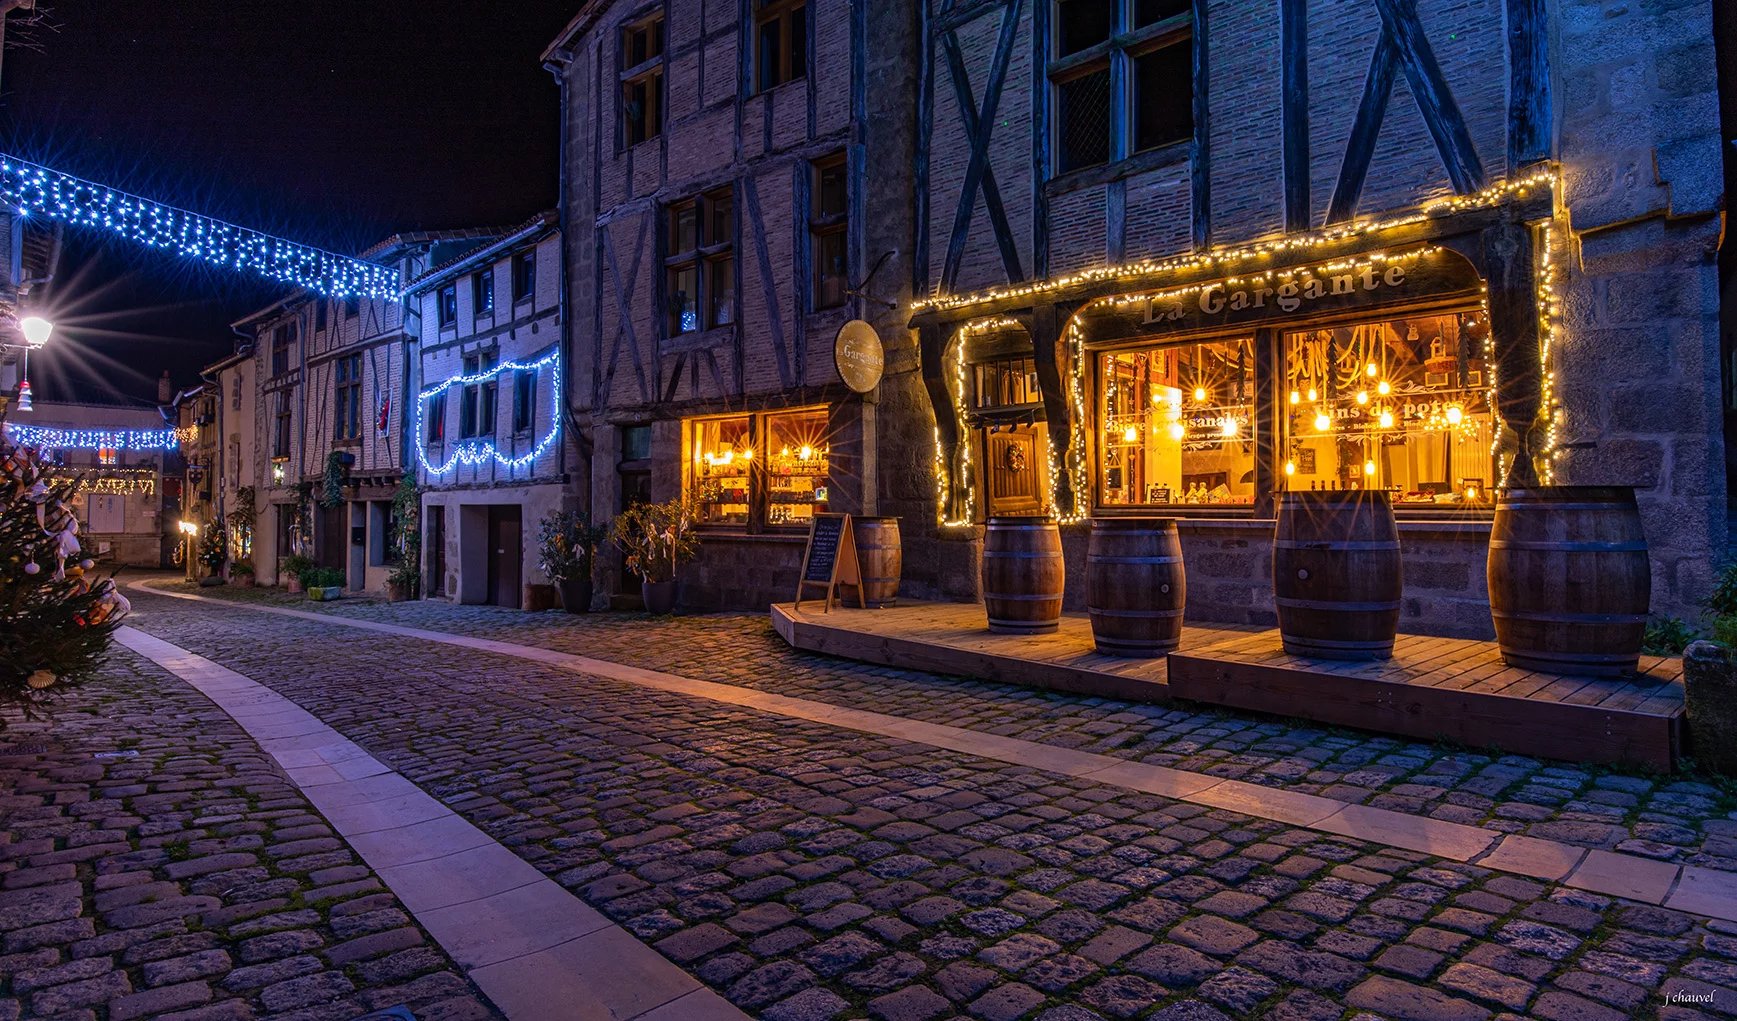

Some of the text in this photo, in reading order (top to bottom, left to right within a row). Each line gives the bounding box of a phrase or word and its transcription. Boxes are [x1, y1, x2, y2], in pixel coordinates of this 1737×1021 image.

[1140, 265, 1406, 325] La Gargante
[1312, 399, 1465, 420] Vins de potes
